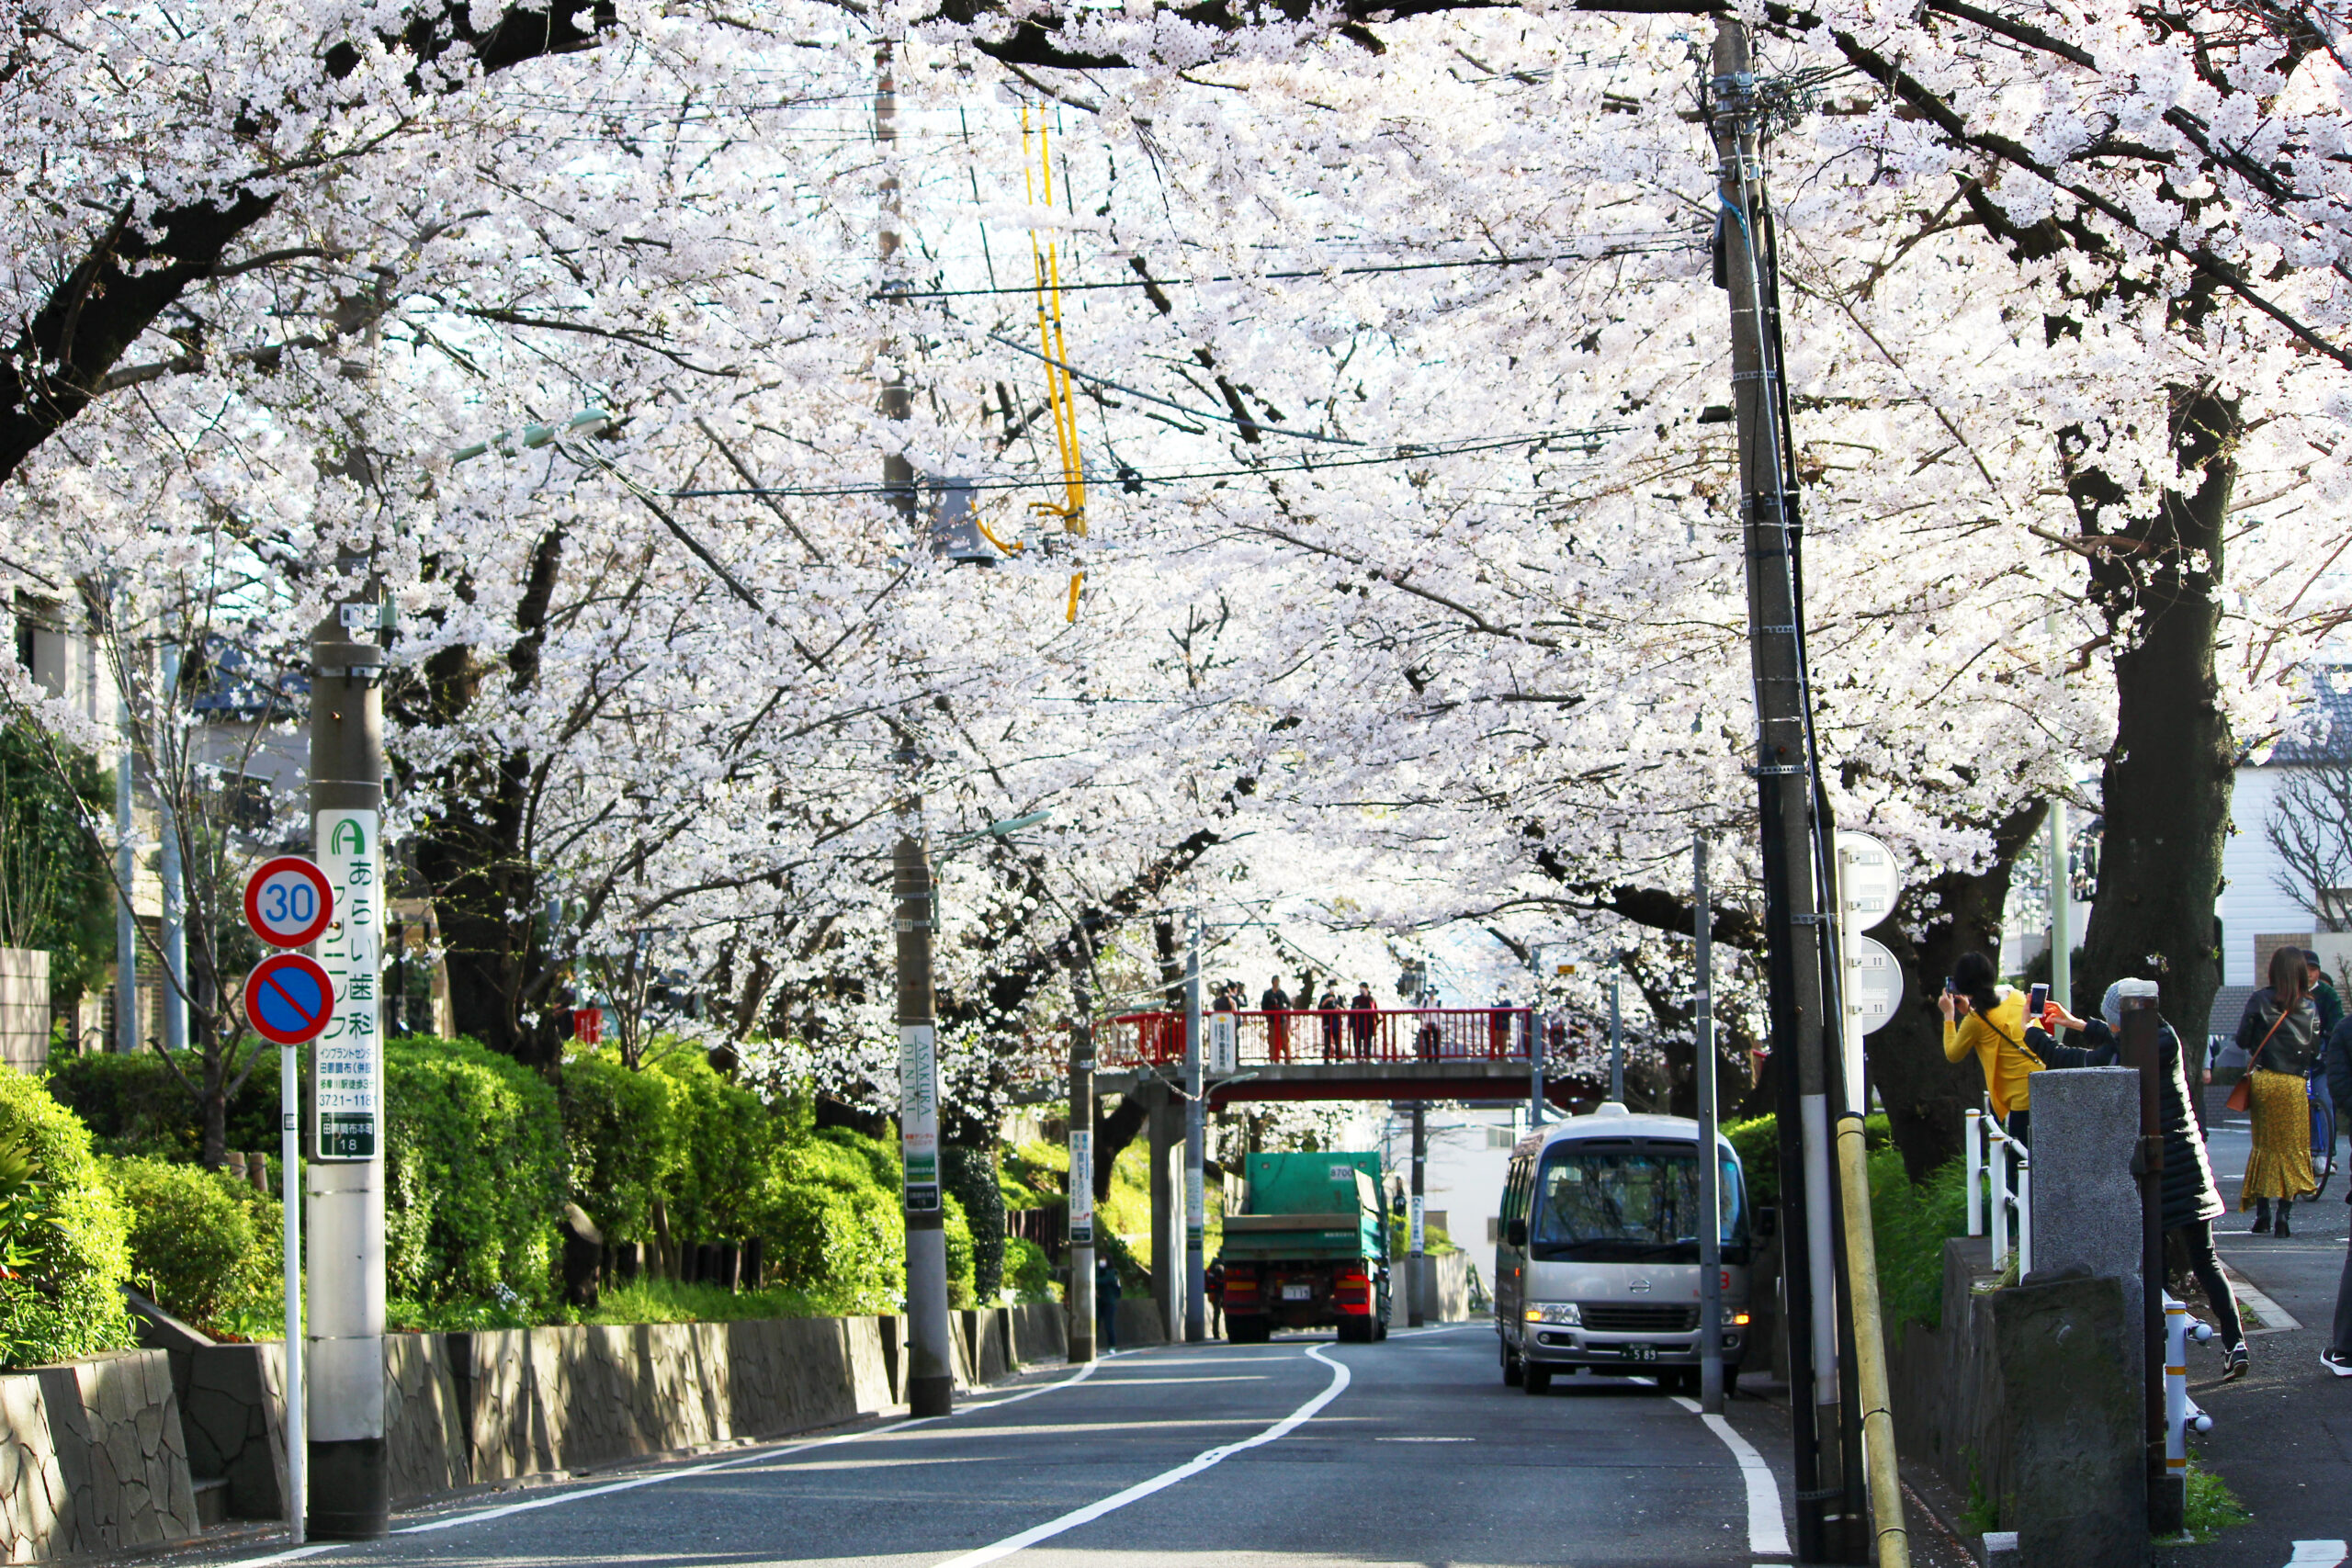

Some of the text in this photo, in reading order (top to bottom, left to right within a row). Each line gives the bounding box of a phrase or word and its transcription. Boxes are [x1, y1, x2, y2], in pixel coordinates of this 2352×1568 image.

[266, 883, 313, 922] 30
[349, 860, 374, 1040] あらい歯科
[903, 1043, 916, 1114] DENTAL
[919, 1041, 932, 1116] ASAKURA
[340, 1139, 357, 1151] 18
